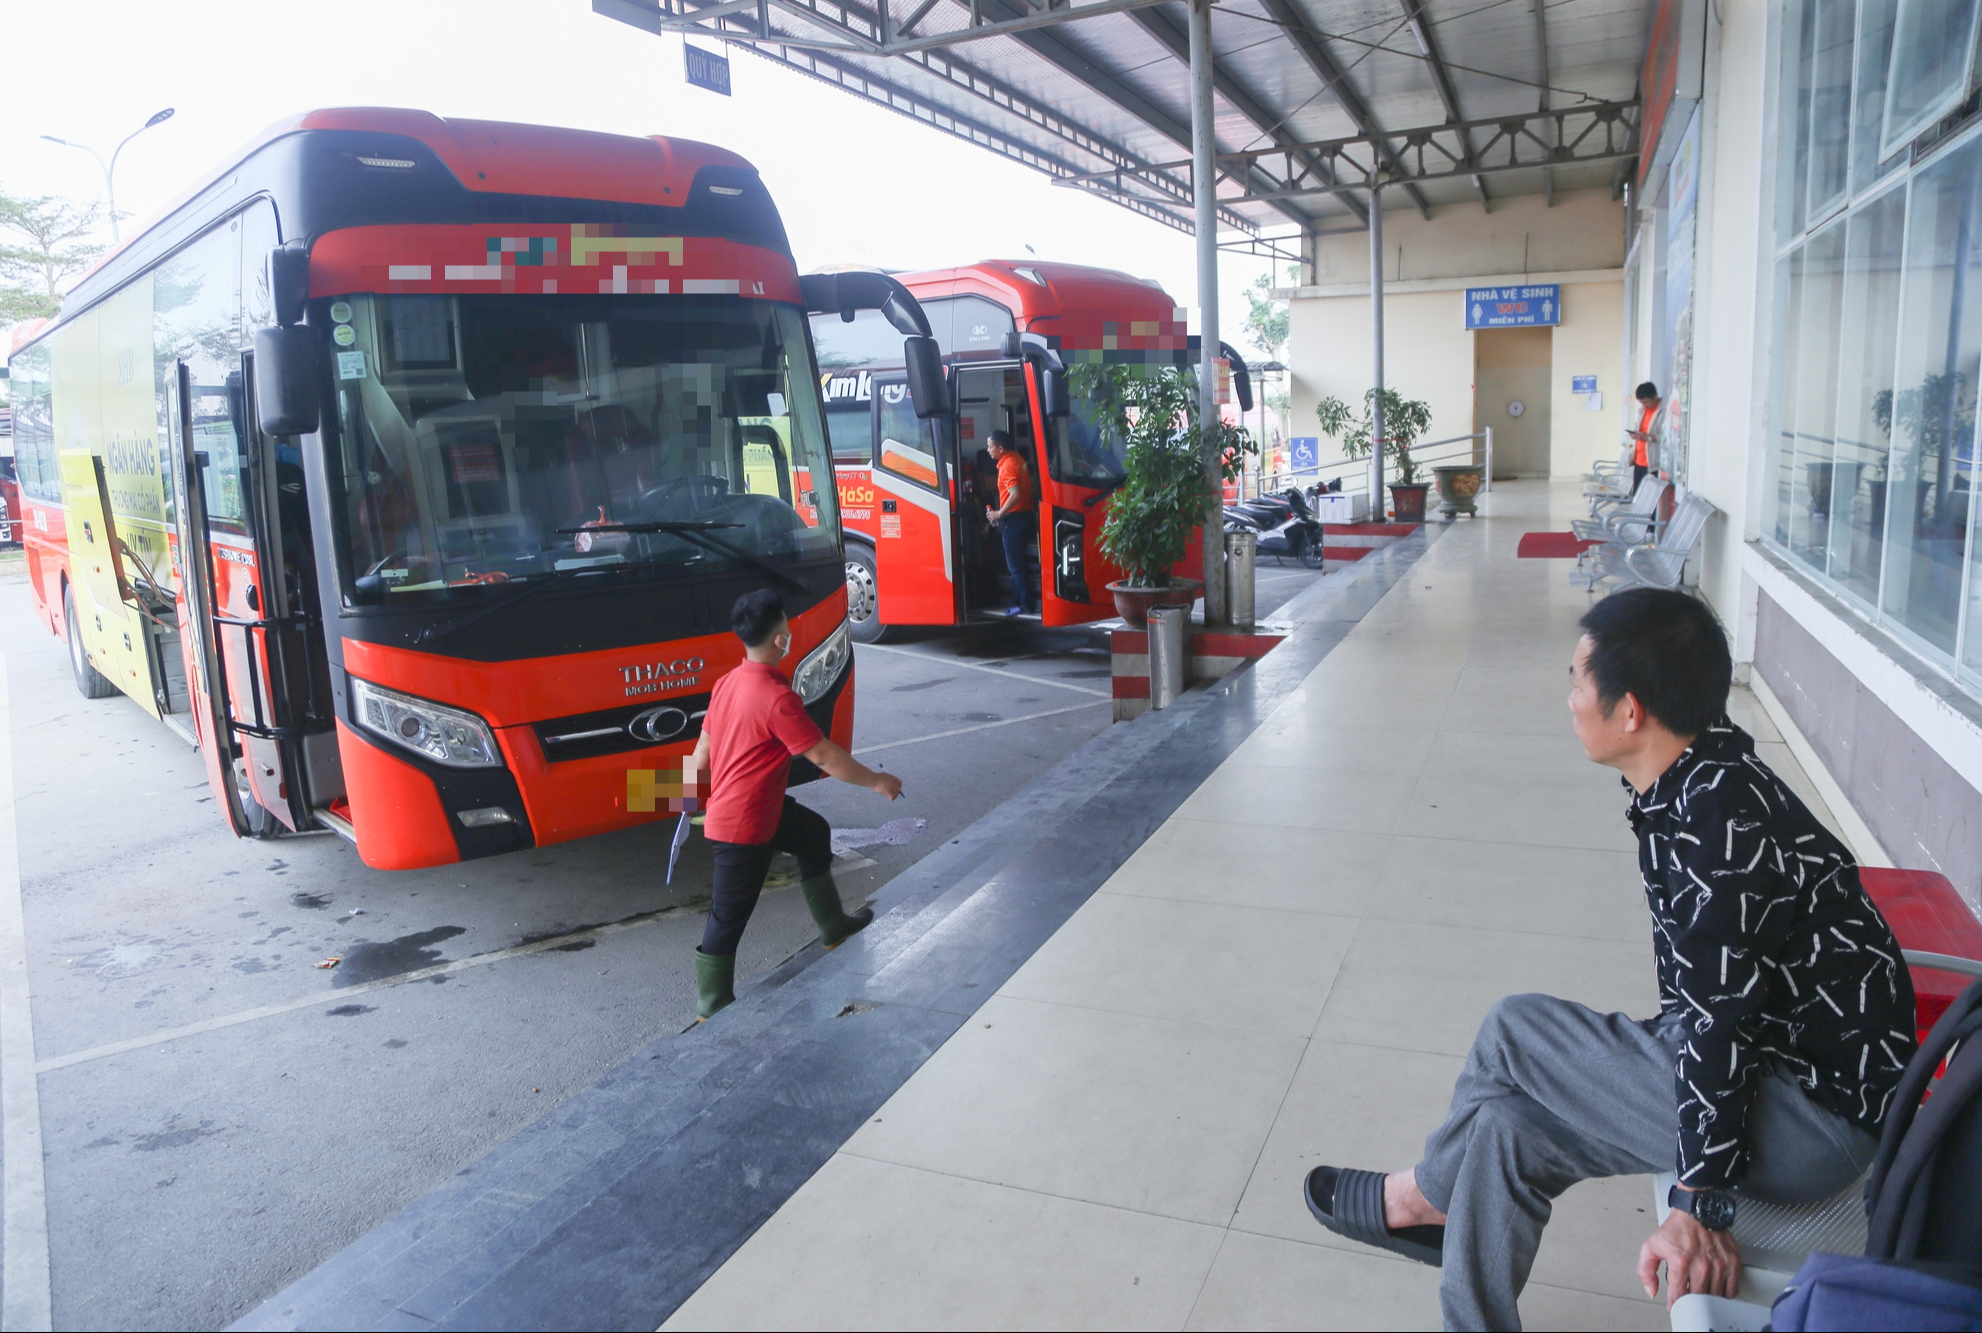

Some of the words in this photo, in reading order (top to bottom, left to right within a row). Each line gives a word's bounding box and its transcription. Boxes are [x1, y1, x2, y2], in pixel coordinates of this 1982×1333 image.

[710, 59, 728, 91] HỢP
[1472, 289, 1498, 301] NHÀ
[1502, 287, 1518, 301] VỆ
[1522, 287, 1553, 299] SINH
[1496, 301, 1528, 314] WC
[1517, 314, 1535, 323] PHÍ
[107, 431, 129, 475] NGÂN
[129, 429, 156, 477] HÀNG
[618, 656, 704, 683] THACO
[625, 683, 657, 697] MOB
[660, 675, 700, 691] HOME
